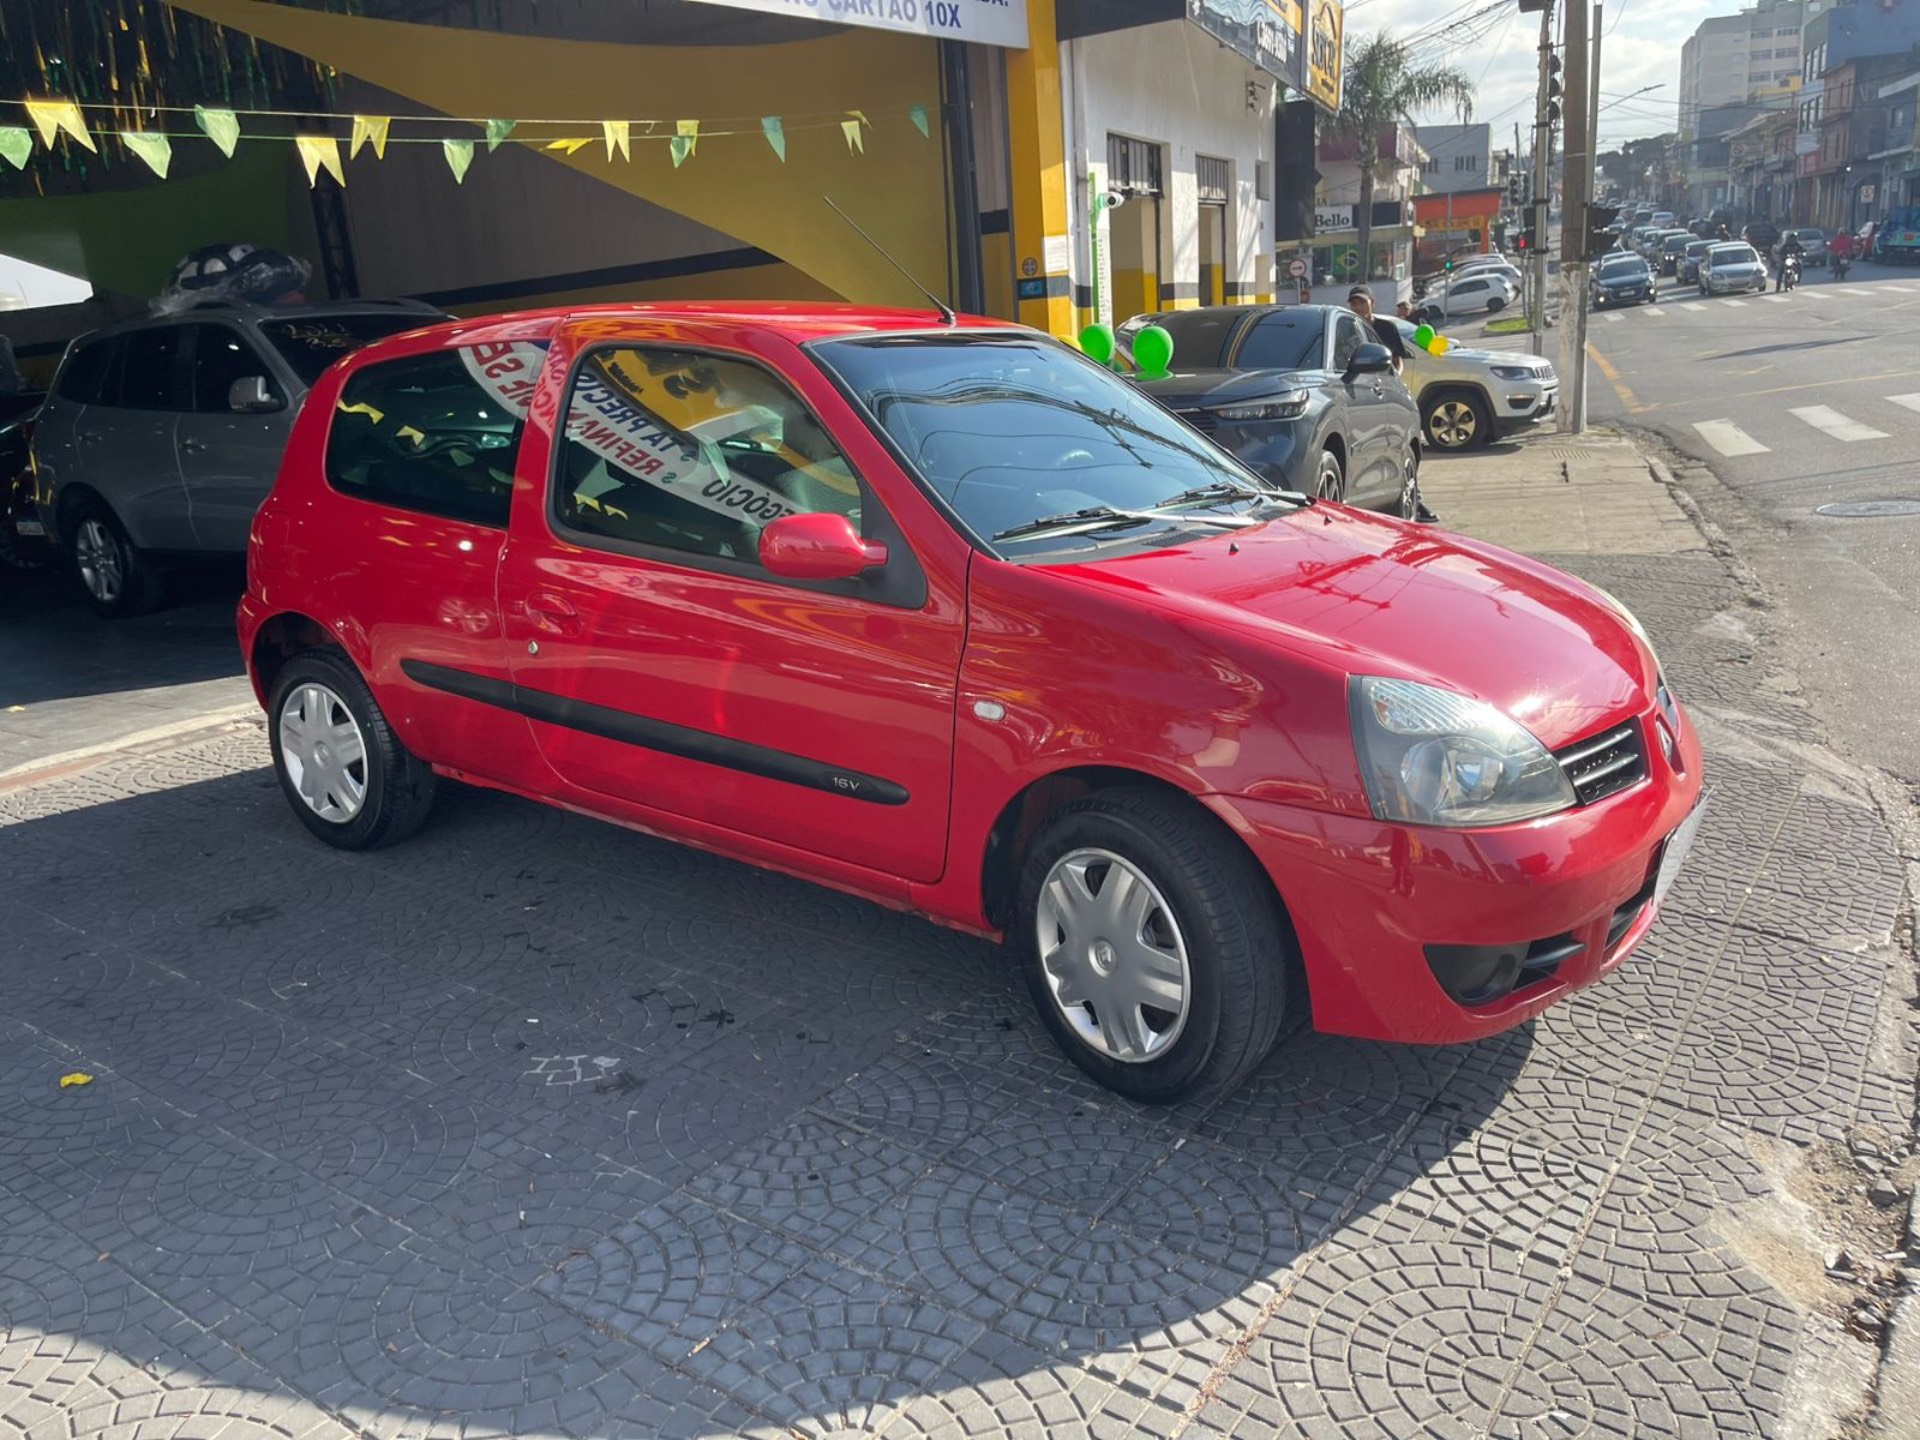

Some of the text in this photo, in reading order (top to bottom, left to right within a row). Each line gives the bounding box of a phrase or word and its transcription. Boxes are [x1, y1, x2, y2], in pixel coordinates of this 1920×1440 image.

[925, 0, 962, 28] 10X
[1315, 213, 1350, 227] Bello
[832, 776, 860, 790] 16V
